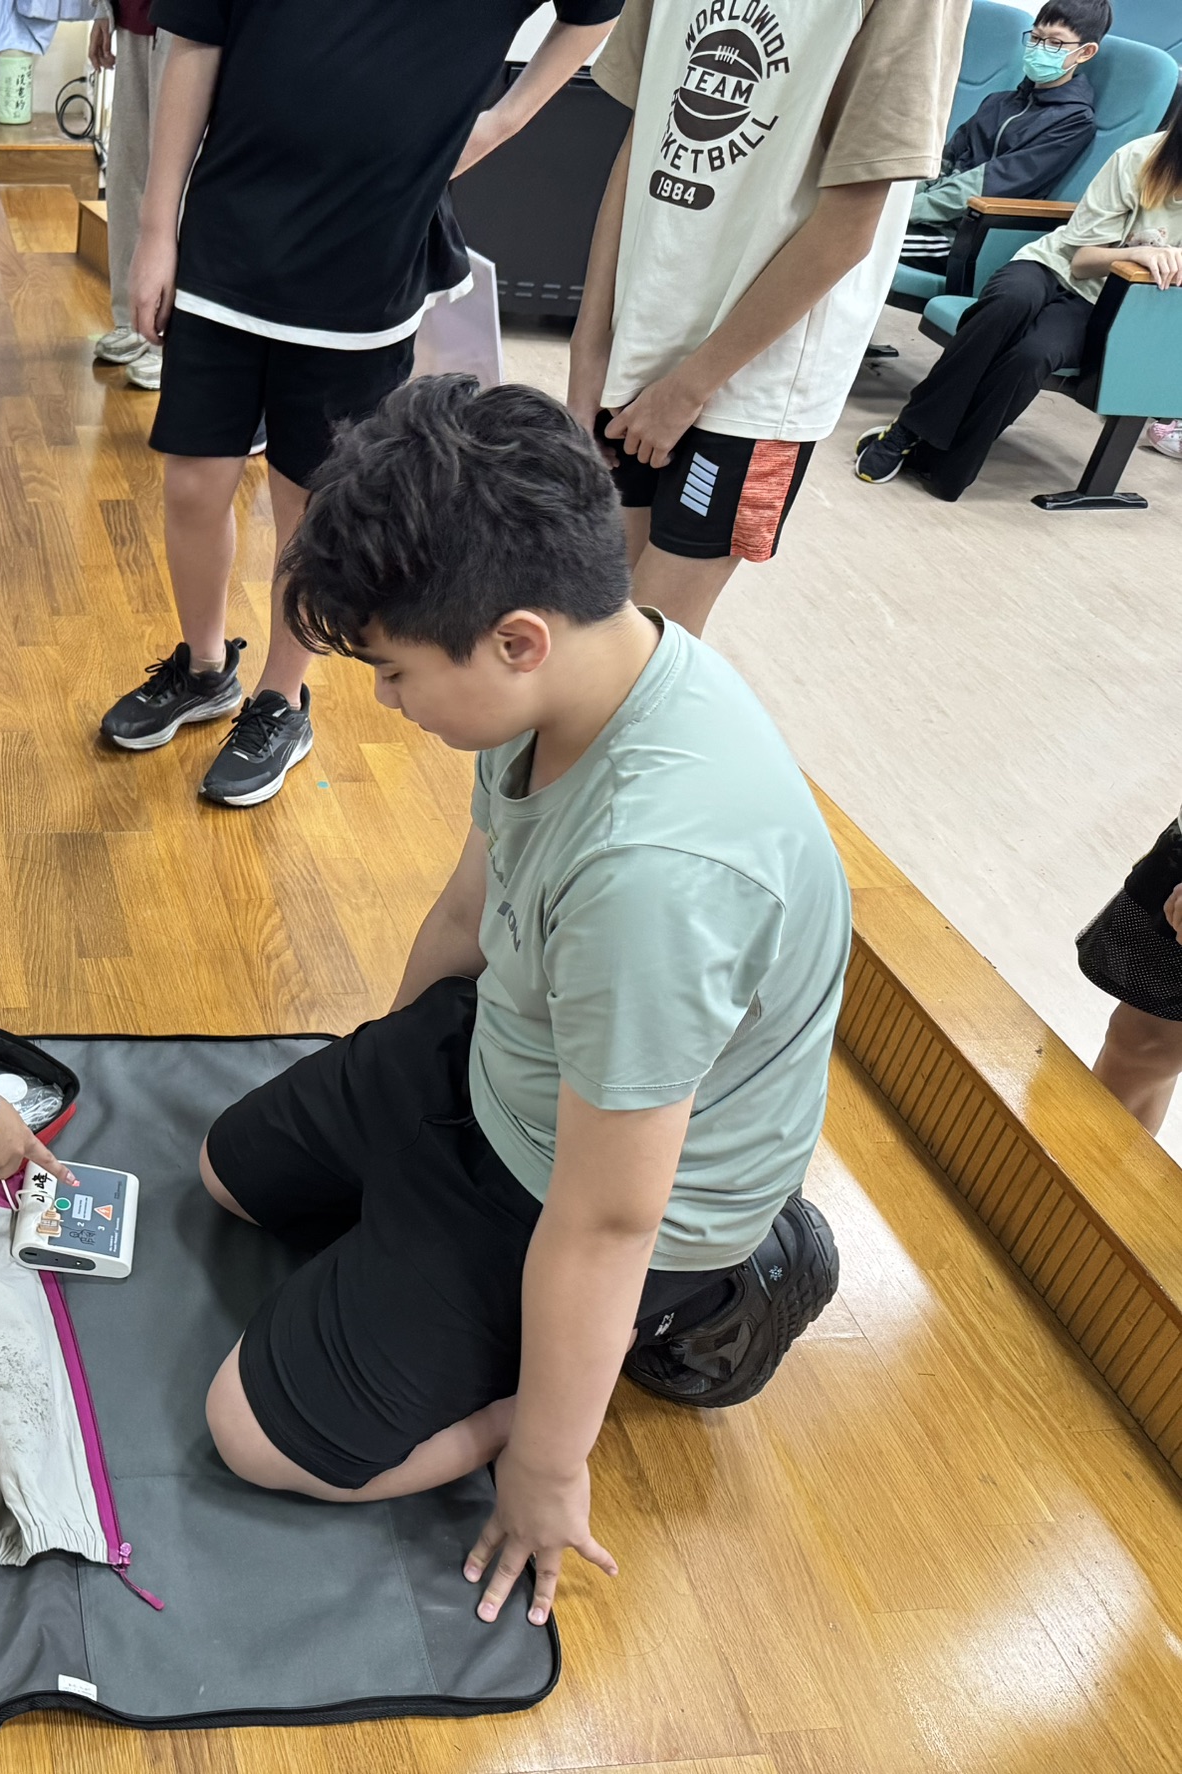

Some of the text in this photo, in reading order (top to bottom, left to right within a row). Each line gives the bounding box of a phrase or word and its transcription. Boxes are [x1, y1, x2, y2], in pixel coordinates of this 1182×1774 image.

[685, 0, 790, 79] WORLDWIDE
[683, 65, 755, 104] TEAM
[656, 177, 696, 204] 1984
